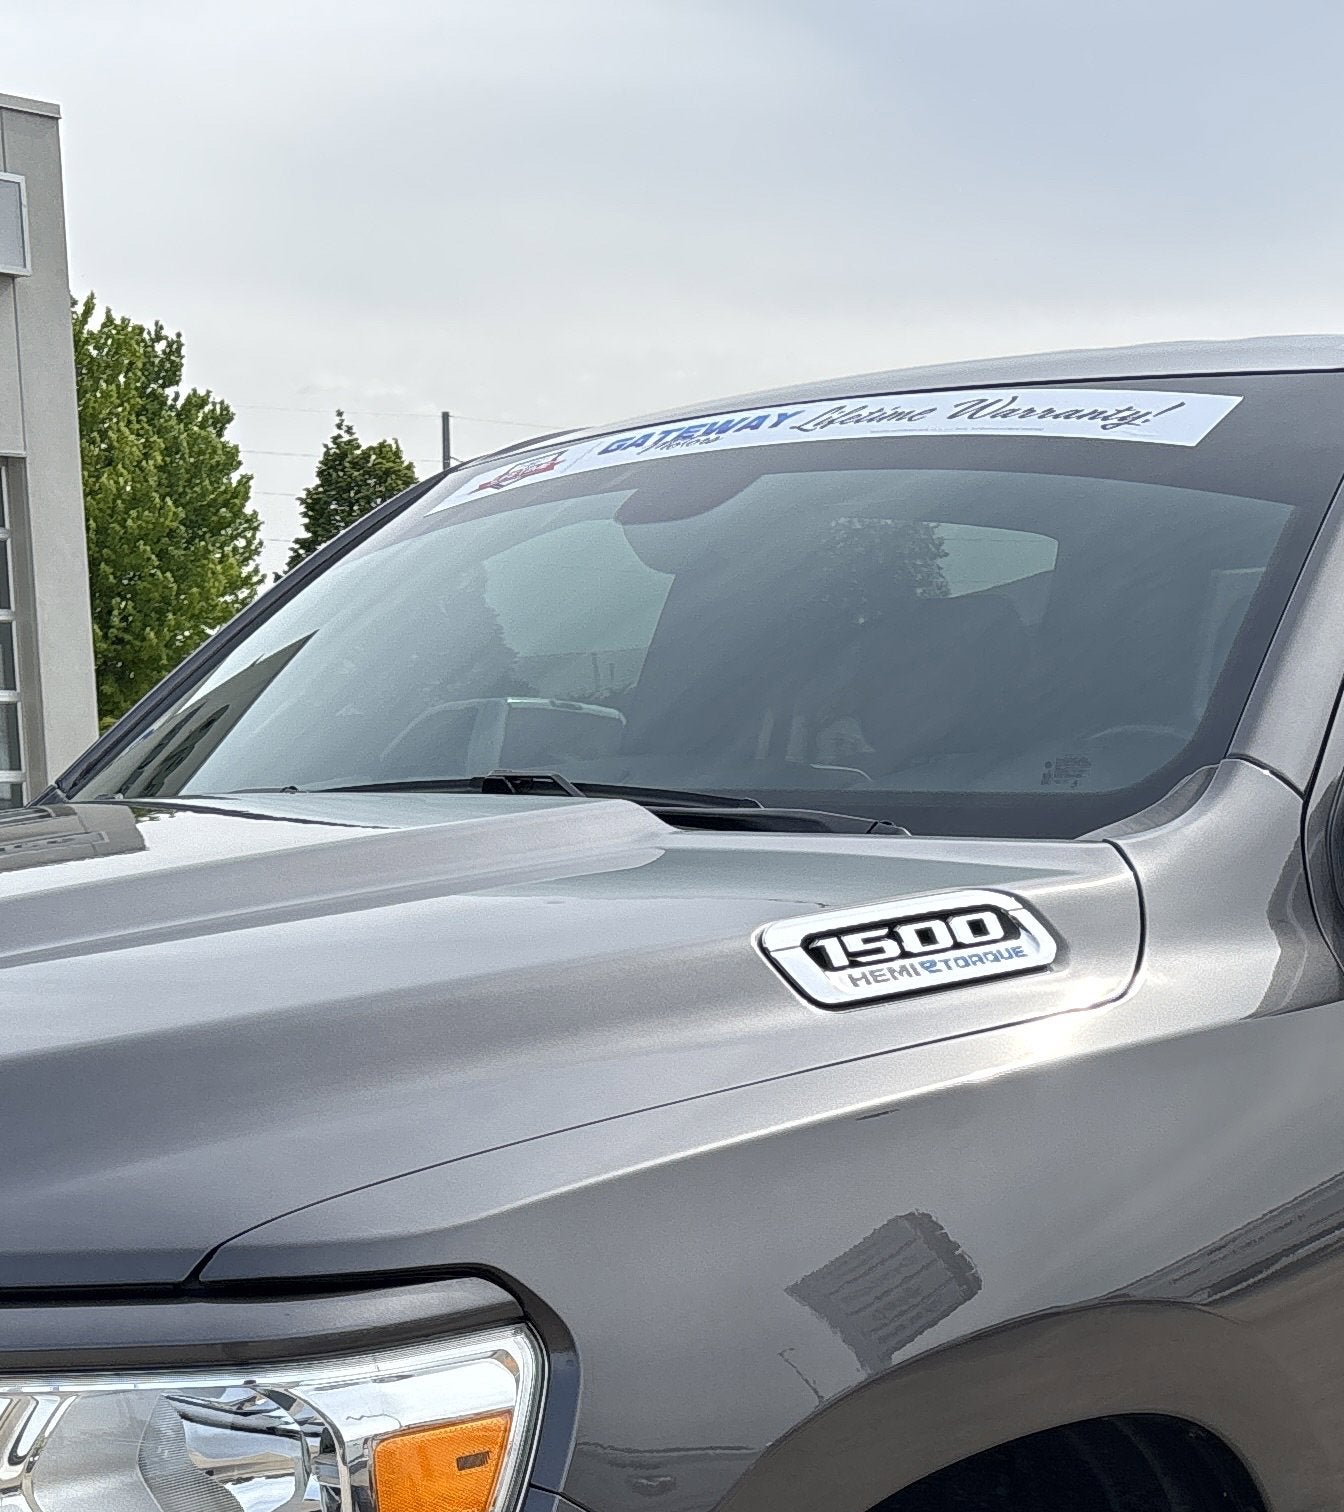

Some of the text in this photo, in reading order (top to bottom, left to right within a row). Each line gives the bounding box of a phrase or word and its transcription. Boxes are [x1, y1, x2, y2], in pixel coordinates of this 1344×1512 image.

[597, 410, 805, 456] GATEWAY
[789, 395, 1186, 433] Lifetime Warranty!
[807, 910, 1006, 969] 1500
[847, 961, 922, 988] HEMI
